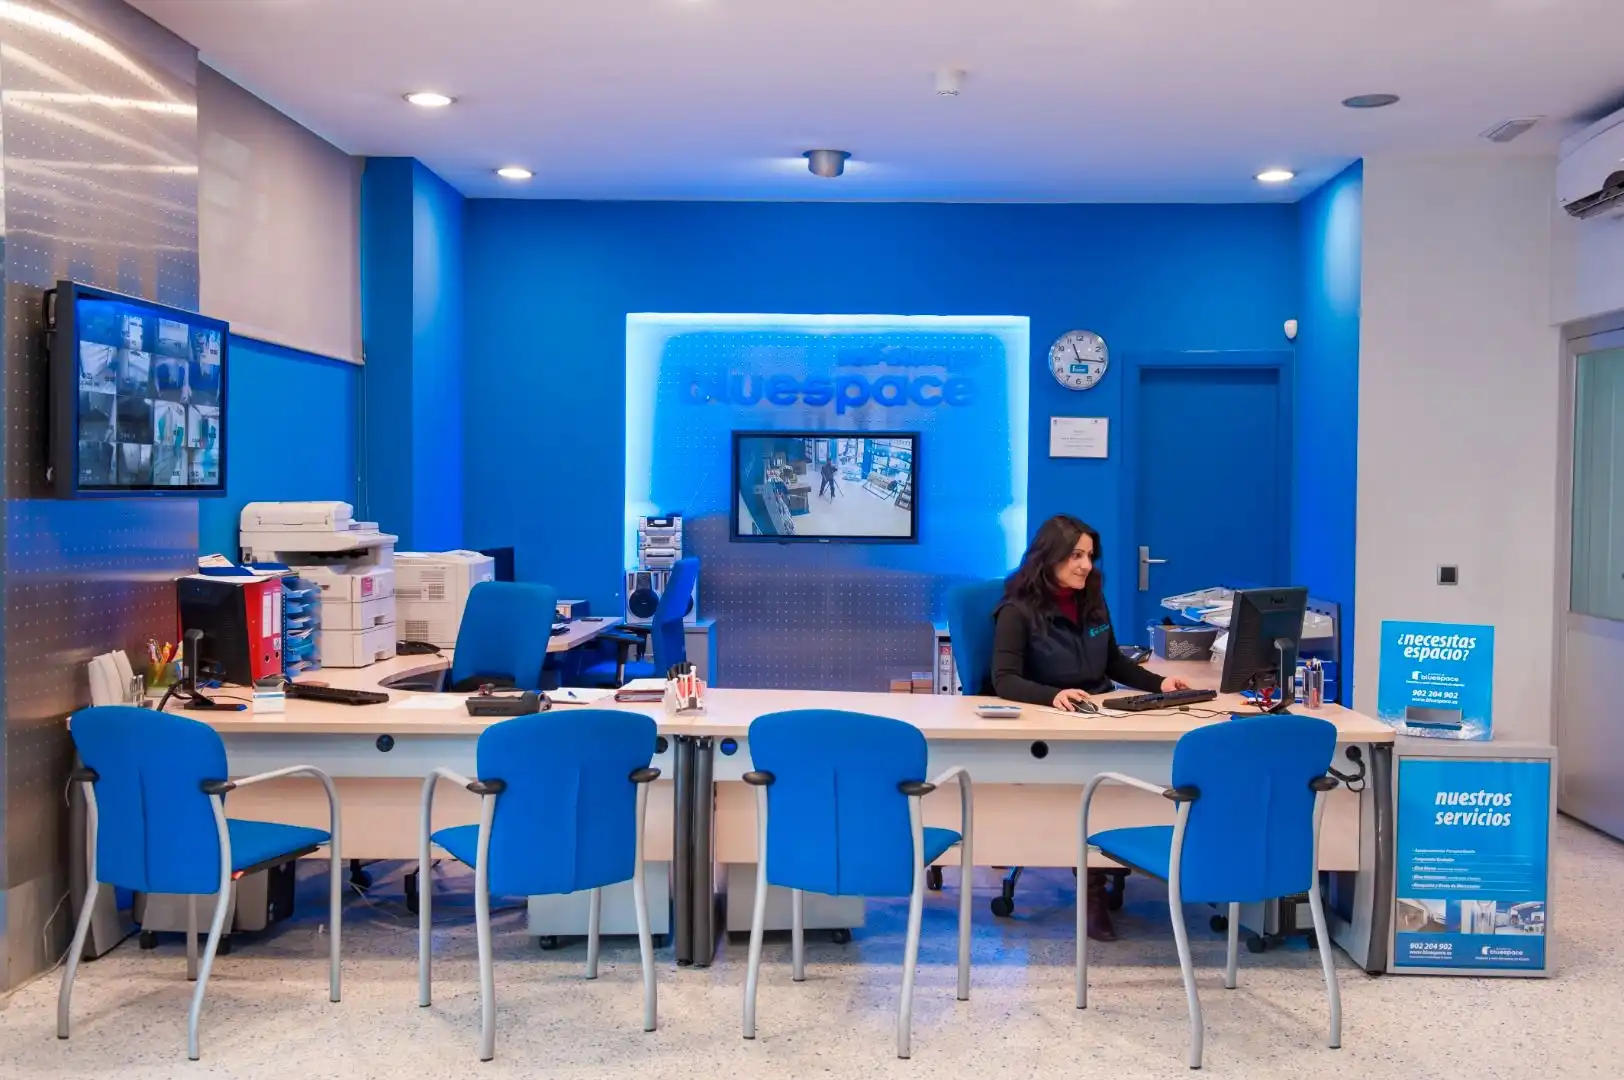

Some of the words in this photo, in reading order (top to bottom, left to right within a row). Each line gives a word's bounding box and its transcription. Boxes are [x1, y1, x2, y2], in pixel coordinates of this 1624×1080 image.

[1397, 634, 1476, 649] ¿necesitas
[1404, 646, 1469, 662] espacio?
[1412, 689, 1427, 697] 902
[1428, 690, 1443, 698] 204
[1444, 691, 1459, 699] 902
[1435, 789, 1513, 806] nuestros
[1434, 807, 1512, 827] servicios
[1409, 942, 1423, 950] 902
[1424, 942, 1438, 950] 204
[1439, 943, 1453, 951] 902
